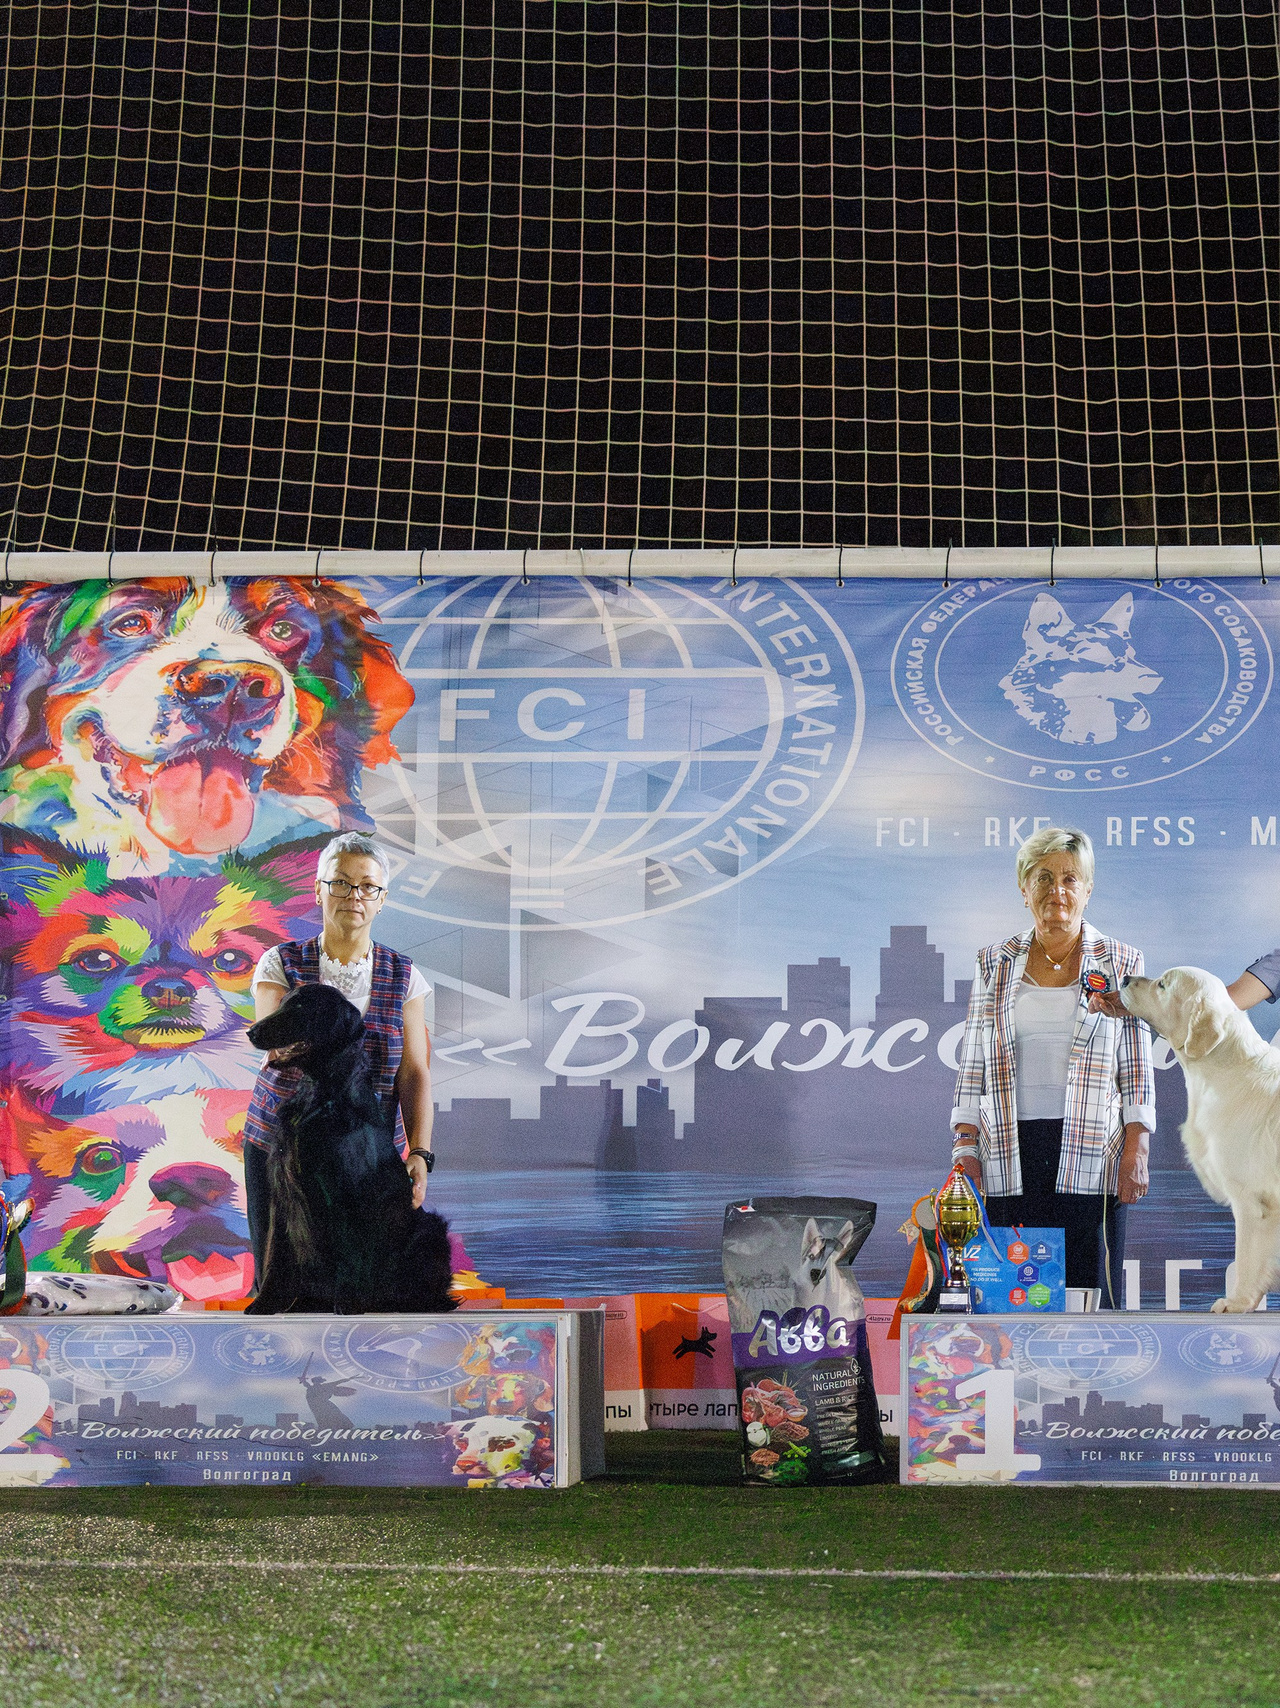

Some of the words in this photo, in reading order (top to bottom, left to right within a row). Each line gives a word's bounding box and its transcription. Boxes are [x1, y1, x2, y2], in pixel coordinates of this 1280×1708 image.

[1194, 605, 1258, 744] СОБАКОВОДСТВА
[904, 637, 964, 746] РОССИЙСКАЯ
[439, 687, 646, 742] FCI
[637, 578, 839, 895] INTERNATIONALE
[1029, 765, 1130, 782] РФСС
[876, 817, 929, 847] FCI
[1106, 816, 1196, 846] RFSS
[812, 1369, 852, 1382] NATURAL
[0, 1369, 67, 1470] 2
[956, 1369, 1041, 1471] 1
[116, 1450, 138, 1461] FCI
[154, 1450, 179, 1461] RKF
[196, 1450, 229, 1462] RFSS
[247, 1451, 304, 1462] VROOKLG
[312, 1452, 379, 1463] «EMANG»
[1081, 1450, 1102, 1461] FCI
[1120, 1450, 1145, 1461] RKF
[1162, 1451, 1196, 1462] RFSS
[1214, 1452, 1272, 1463] VROOKLG
[203, 1468, 292, 1483] Волгоград
[1169, 1470, 1260, 1484] Волгоград
